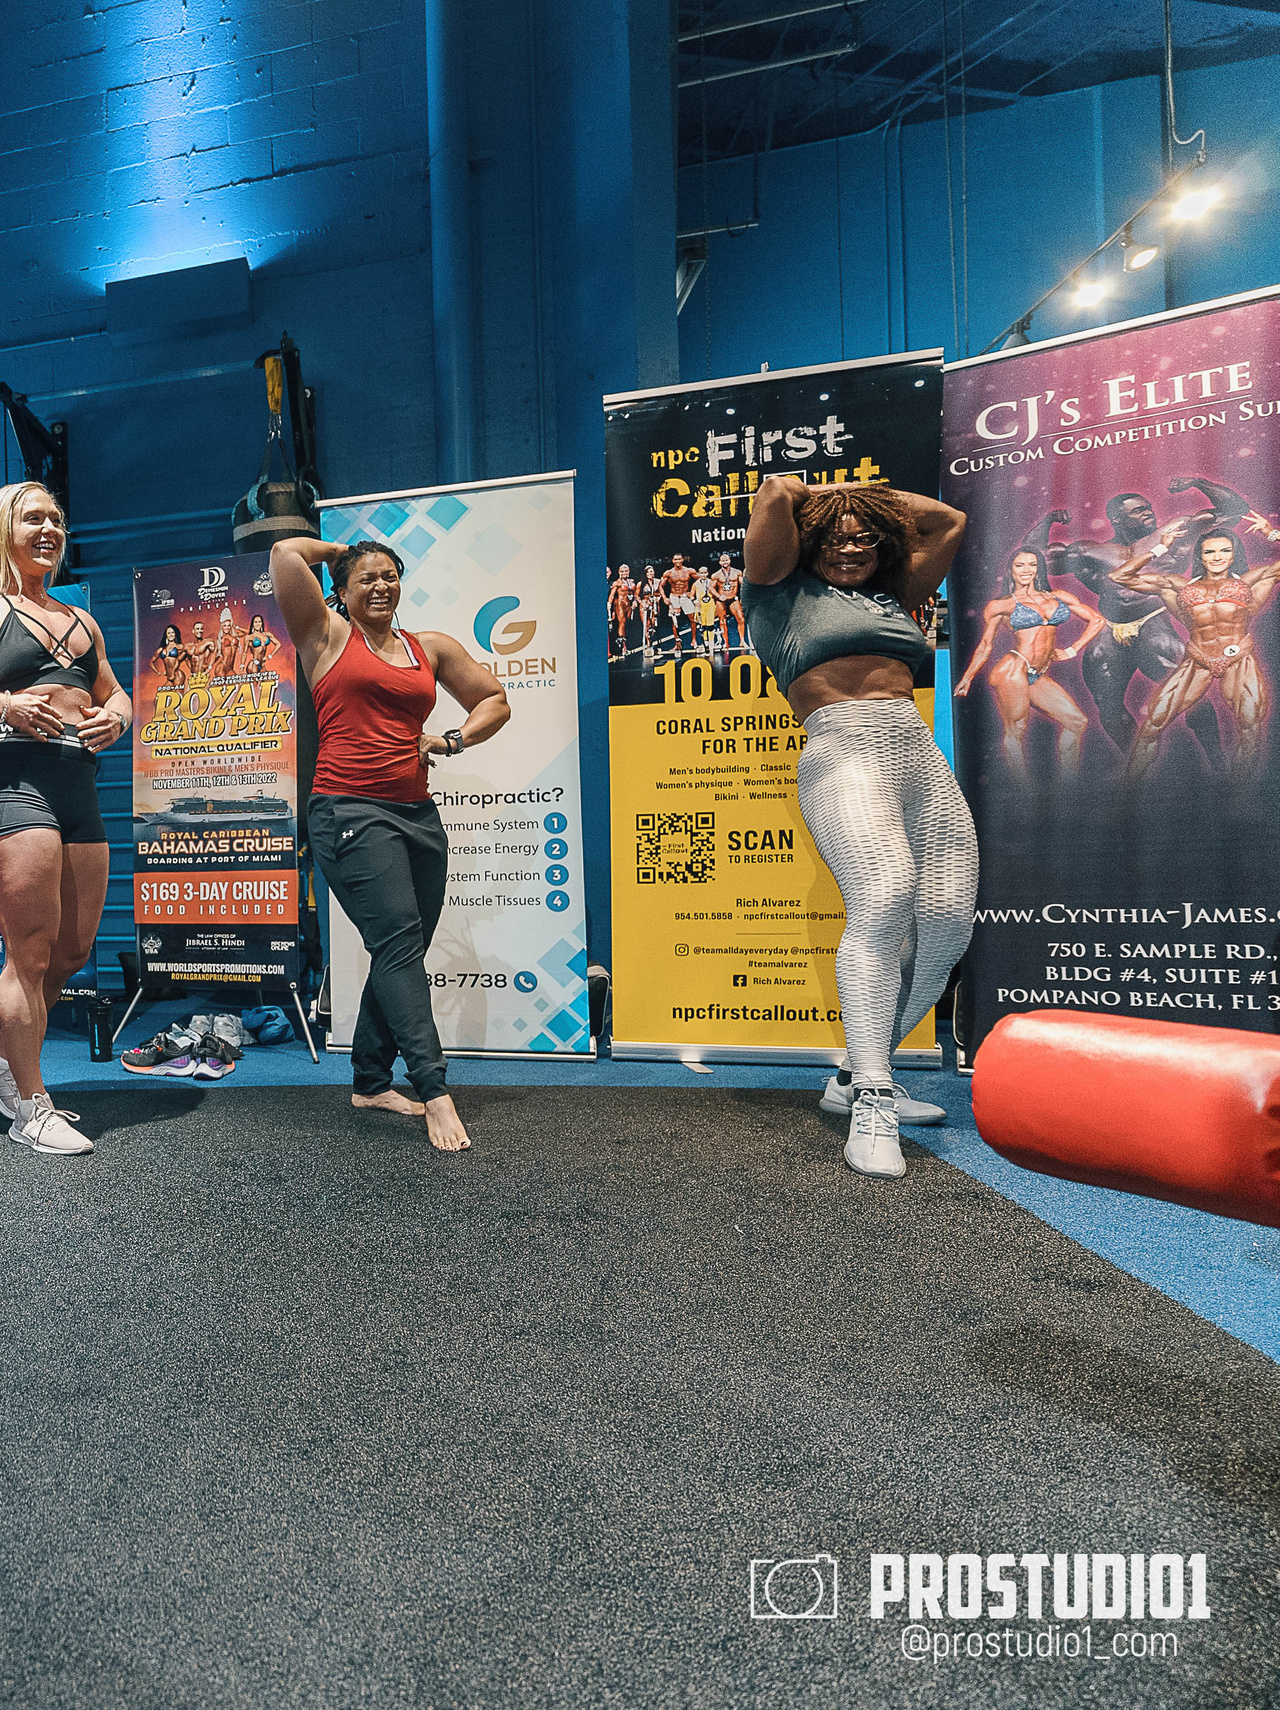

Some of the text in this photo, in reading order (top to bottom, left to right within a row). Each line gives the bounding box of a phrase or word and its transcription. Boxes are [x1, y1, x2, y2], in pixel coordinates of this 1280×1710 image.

[651, 415, 853, 477] npc First
[692, 527, 746, 543] Nation
[181, 599, 246, 613] PRESENTS
[480, 657, 556, 677] OLDEN
[501, 679, 556, 690] PRACTIC
[152, 680, 281, 722] ROYAL
[140, 711, 293, 745] GRAND PRIX
[656, 713, 801, 735] CORAL SPRINGS
[154, 740, 278, 757] NATIONAL QUALIFIER
[702, 736, 779, 754] FOR THE
[171, 755, 261, 768] OPEN WORLDWIDE
[160, 768, 174, 777] PRO
[175, 766, 205, 777] MASTERS
[206, 765, 226, 775] BIKINI
[227, 765, 233, 774] &
[235, 763, 254, 773] MEN'S
[256, 761, 289, 771] PHYSIQUE
[669, 763, 791, 776] Men's bodybuilding Classic
[153, 772, 277, 790] NOVEMBER 11TH, 12TH & 13TH 2022
[655, 777, 782, 790] Women's physique Women's
[430, 787, 564, 809] Chiropractic?
[714, 792, 787, 801] Bikini Wellness
[442, 818, 558, 833] mmune System 1
[161, 829, 270, 840] ROYAL CARIBBEAN
[728, 829, 794, 851] SCAN
[138, 837, 294, 855] BAHAMAS CRUISE
[447, 843, 560, 856] ncrease Energy 2
[147, 854, 281, 865] BOARDING AT PORT OF MIAMI
[728, 854, 794, 863] TO REGISTER
[446, 870, 561, 882] ystem Function 3
[140, 880, 289, 902] $169 3-DAY CRUISE
[449, 895, 562, 906] Muscle Tissues 4
[736, 898, 801, 907] Rich Alvarez
[144, 904, 285, 915] FOOD INCLUDED
[674, 911, 847, 922] 954.501.5858 npcfirstcallout@gmail.
[186, 939, 212, 947] JIBRAEL
[223, 939, 245, 947] HINDI
[693, 946, 788, 956] @teamalldayeveryday
[1047, 943, 1278, 962] 750 E. SAMPLE RD.,
[147, 962, 285, 974] WWW.WORLDSPORTSPROMOTIONS.COM
[748, 960, 808, 968] #teamalvarez
[171, 973, 261, 982] ROYALGRANDPRIX@GMAIL.COM
[753, 977, 806, 986] Rich Alvarez
[1045, 966, 1111, 983] BLDG
[1119, 968, 1158, 985] #4,
[1165, 968, 1241, 985] SUITE
[997, 988, 1280, 1011] POMPANO BEACH, FL 3
